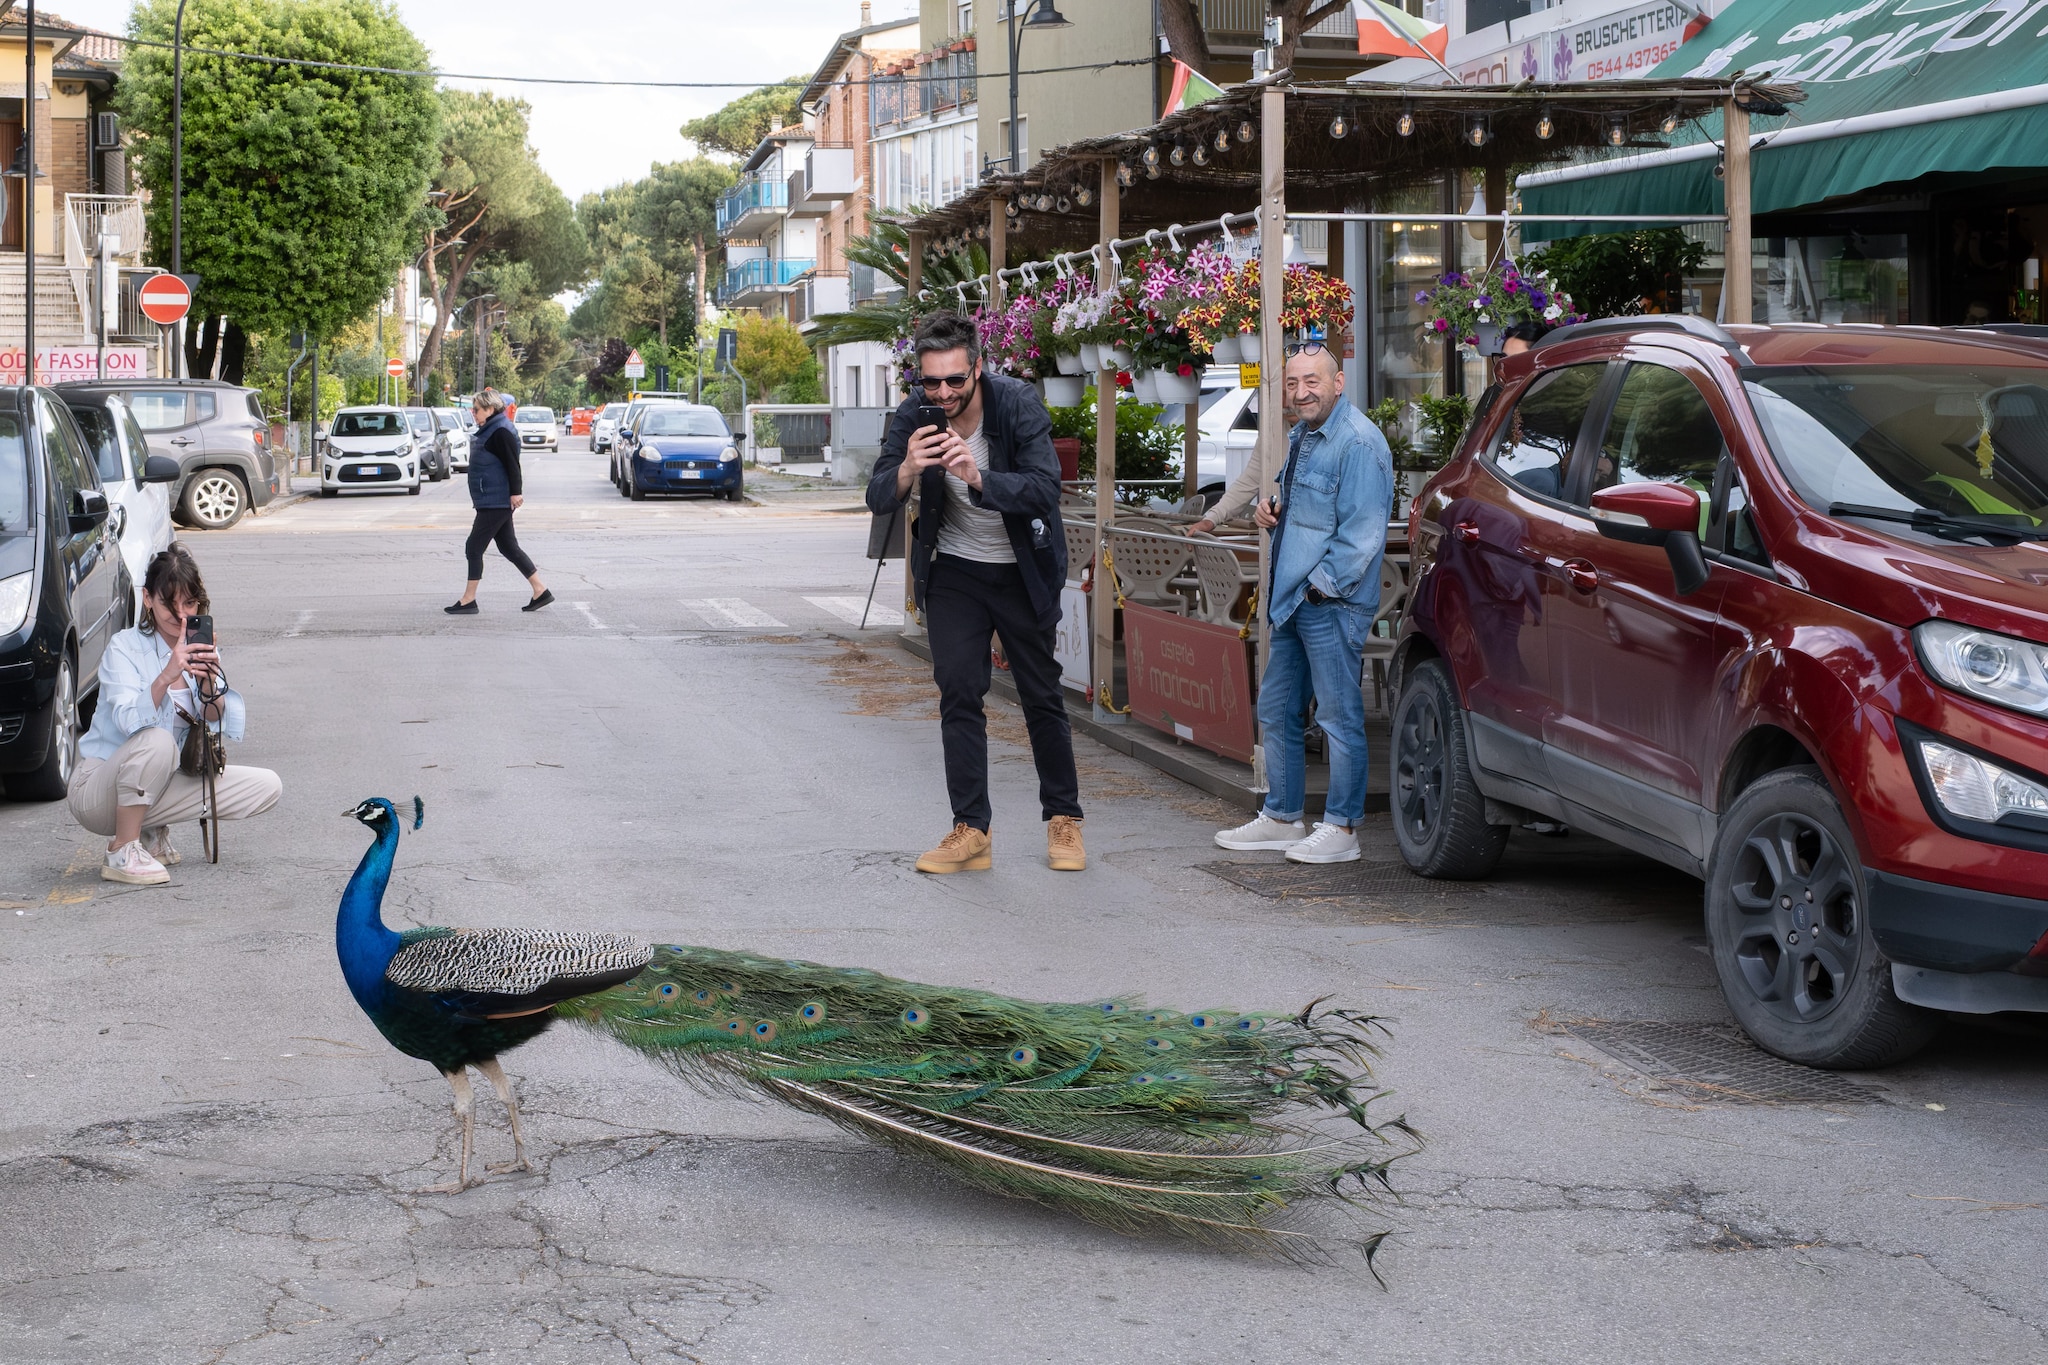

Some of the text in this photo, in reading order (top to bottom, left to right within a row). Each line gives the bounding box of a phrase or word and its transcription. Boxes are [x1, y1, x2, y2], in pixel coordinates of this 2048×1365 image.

[1576, 5, 1688, 55] BRUSCHETTERIA
[1587, 41, 1677, 80] 0544 437365
[49, 353, 136, 369] FASHON
[1160, 639, 1195, 667] osteria
[1150, 665, 1217, 715] moriconi
